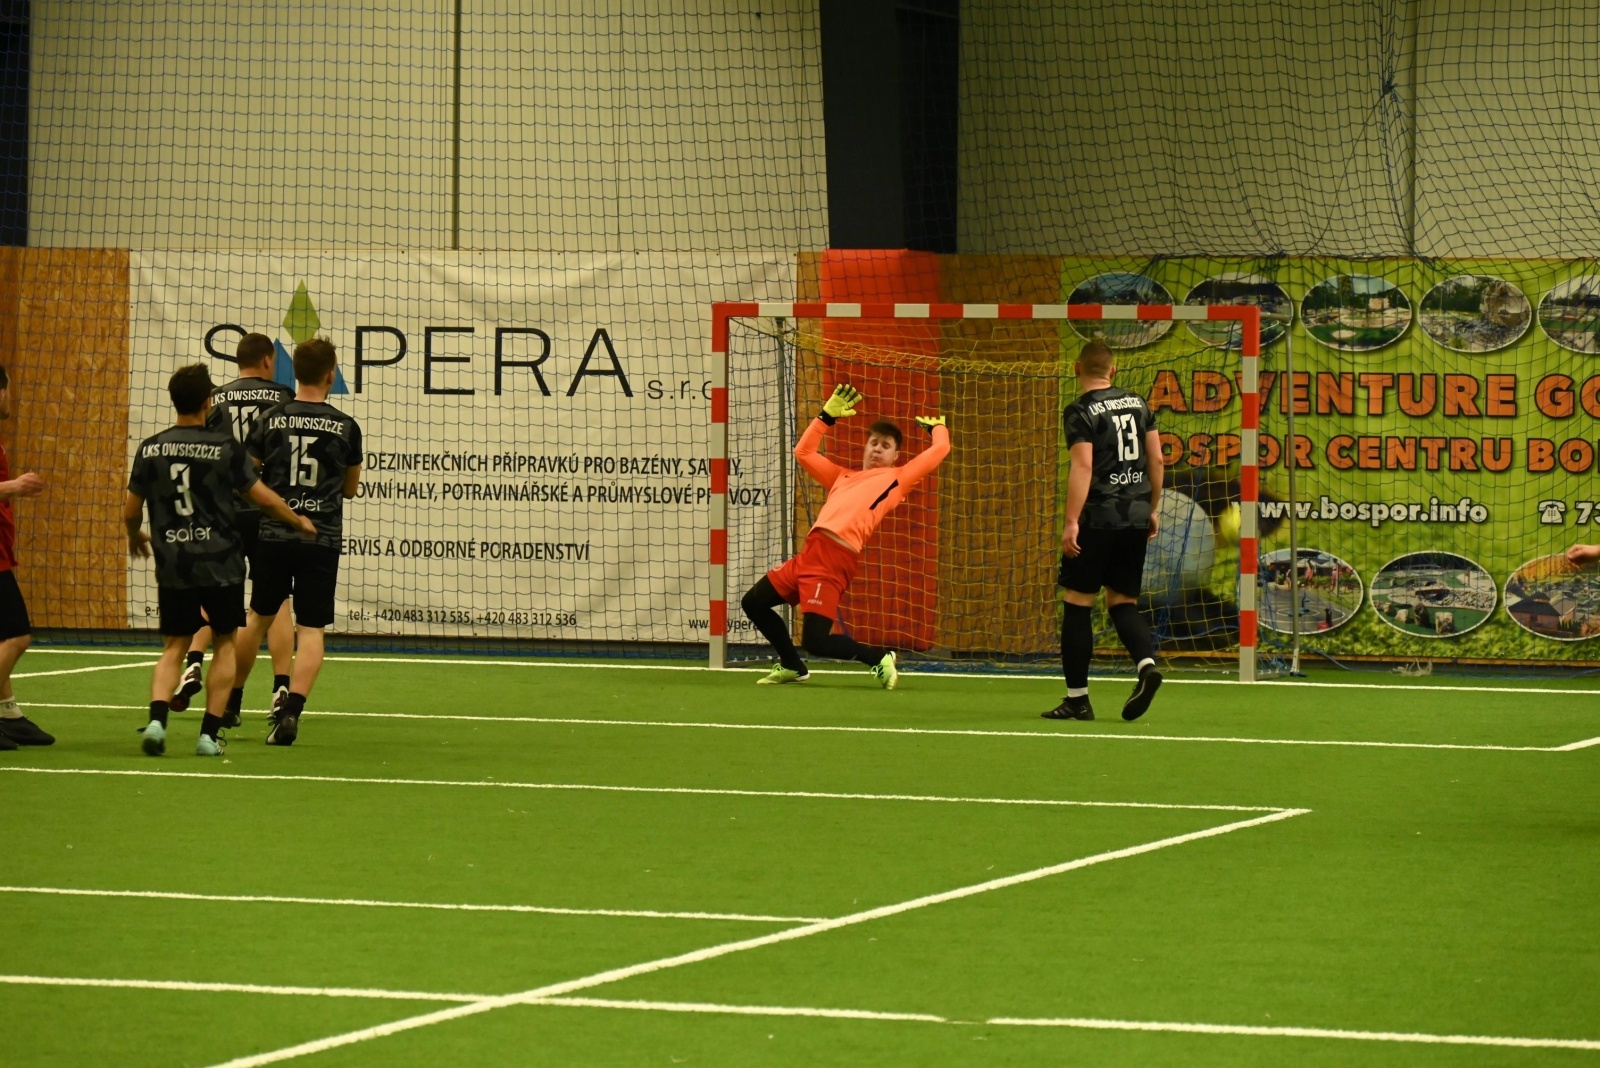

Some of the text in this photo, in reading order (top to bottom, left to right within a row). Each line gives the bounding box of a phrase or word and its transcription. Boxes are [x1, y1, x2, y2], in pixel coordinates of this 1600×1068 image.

[210, 389, 281, 406] LKS OWSISZCZE
[1148, 369, 1518, 418] ADVENTURE
[1089, 397, 1142, 416] LKS OWSISZCZE
[229, 405, 260, 444] 10
[269, 415, 344, 435] LKS OWSISZCZE
[1112, 413, 1139, 462] 13
[142, 442, 222, 460] LKS OWSISZCZE
[288, 435, 319, 487] 15
[1160, 432, 1600, 474] OSPOR CENTRU BO
[366, 451, 743, 479] DEZINFEKČNÍCH PŘÍPRAVKÚ PRO BAZÉNY, SAY,
[1109, 466, 1144, 485] safer
[170, 462, 194, 516] 3
[355, 478, 771, 506] OVNÍ HALY, POTRAVINÁŘSKÉ A PRŮMYSLOVÉ PVOZY
[280, 492, 323, 511] afer
[165, 522, 211, 543] safer
[340, 538, 590, 560] ERVIS A ODBORNÉ PORADENSTVÍ
[375, 609, 401, 622] +420
[403, 610, 424, 622] 483
[427, 610, 446, 623] 312
[476, 612, 505, 625] +420
[508, 612, 528, 625] 483
[532, 613, 552, 626] 312
[555, 613, 577, 627] 536
